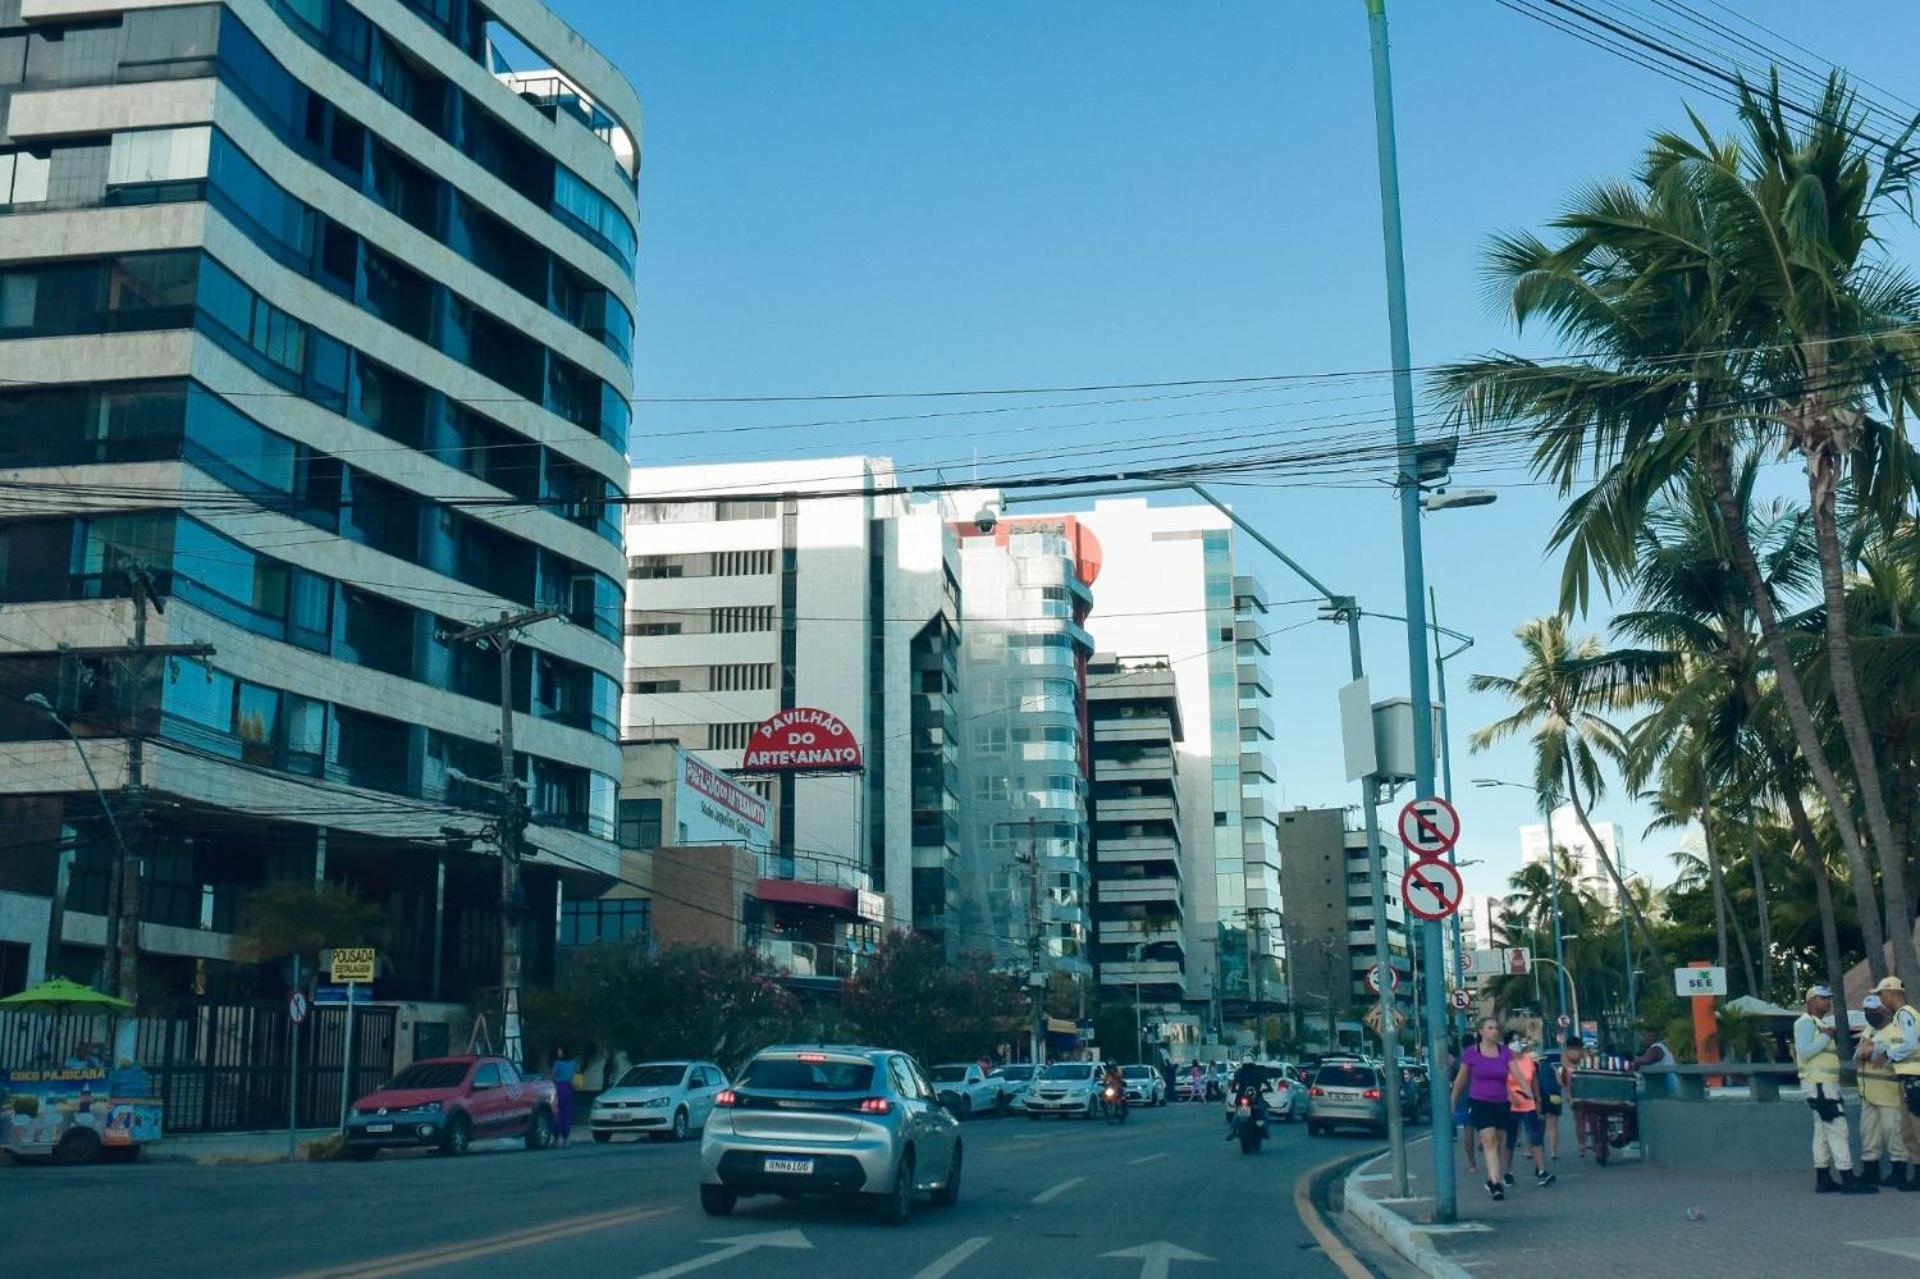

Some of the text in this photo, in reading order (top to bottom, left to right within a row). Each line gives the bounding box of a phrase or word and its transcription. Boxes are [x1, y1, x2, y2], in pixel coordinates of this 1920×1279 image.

[761, 710, 844, 738] PAVILHÃO
[788, 731, 816, 745] DO
[332, 950, 373, 963] POUSADA
